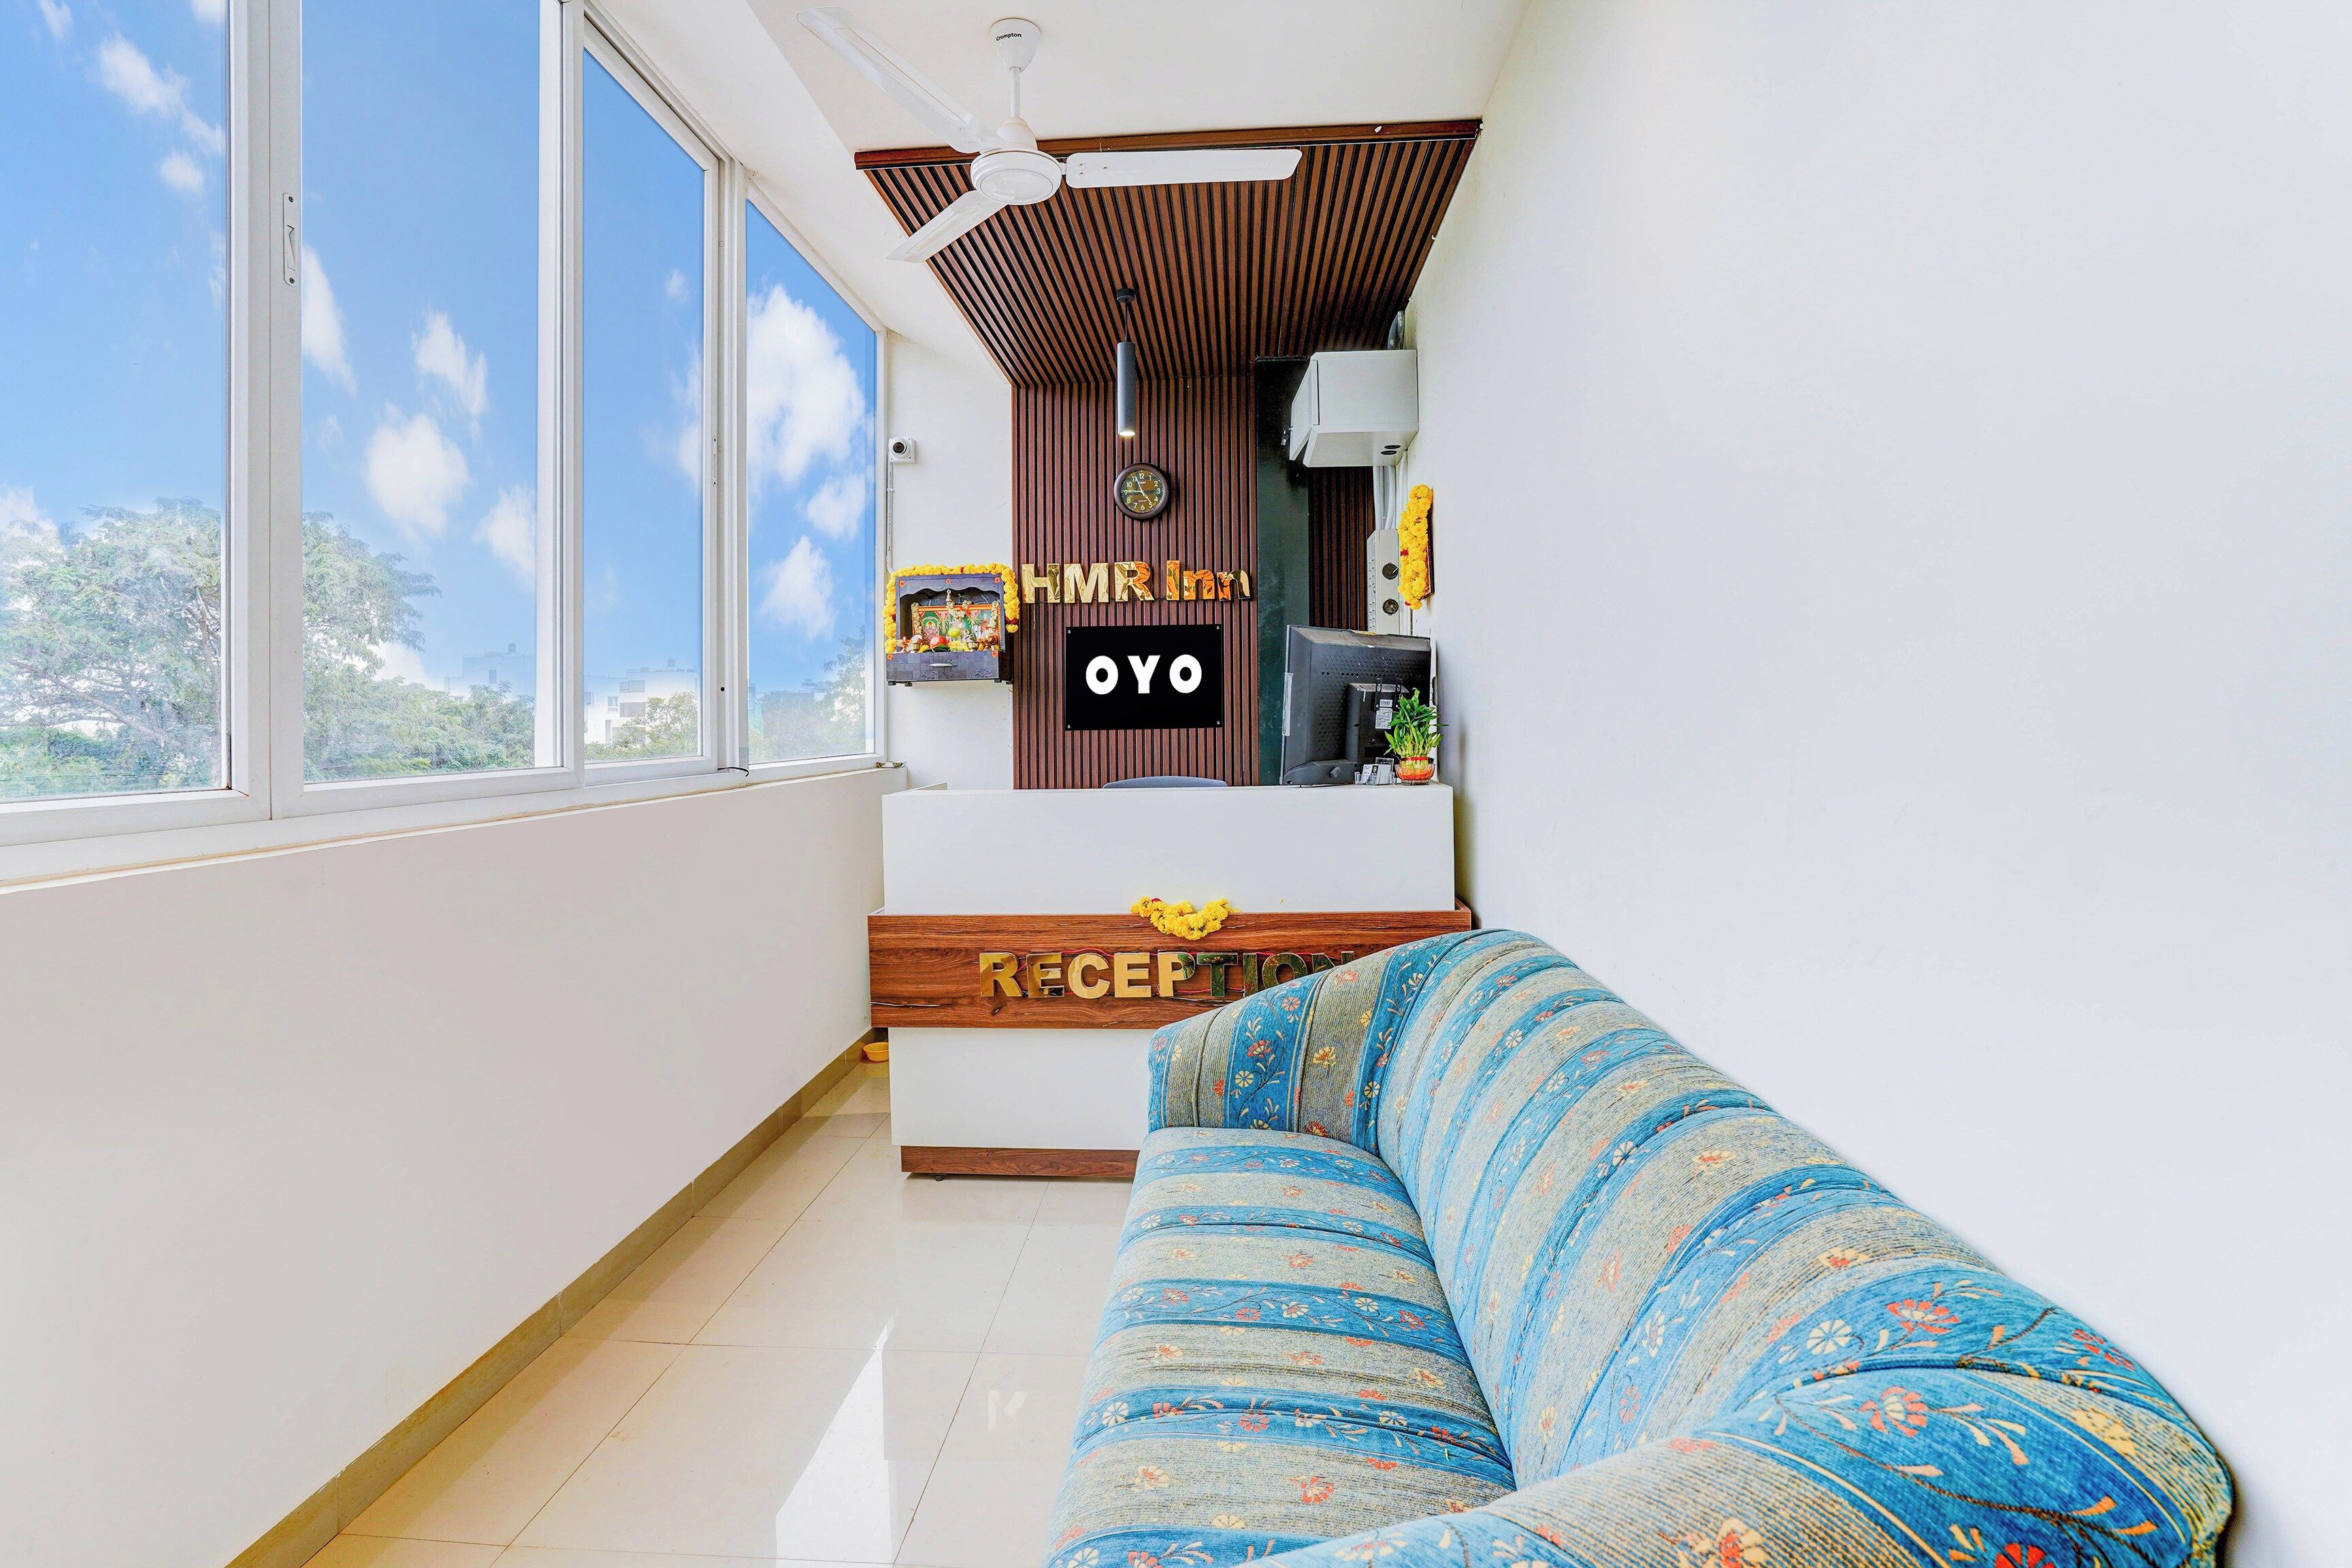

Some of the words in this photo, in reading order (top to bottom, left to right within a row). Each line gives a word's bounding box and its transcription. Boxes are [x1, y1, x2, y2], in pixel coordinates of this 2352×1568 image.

[996, 33, 1022, 42] Crompton
[1022, 561, 1155, 604] HMR
[1166, 560, 1252, 602] Inn
[1085, 654, 1203, 695] OYO
